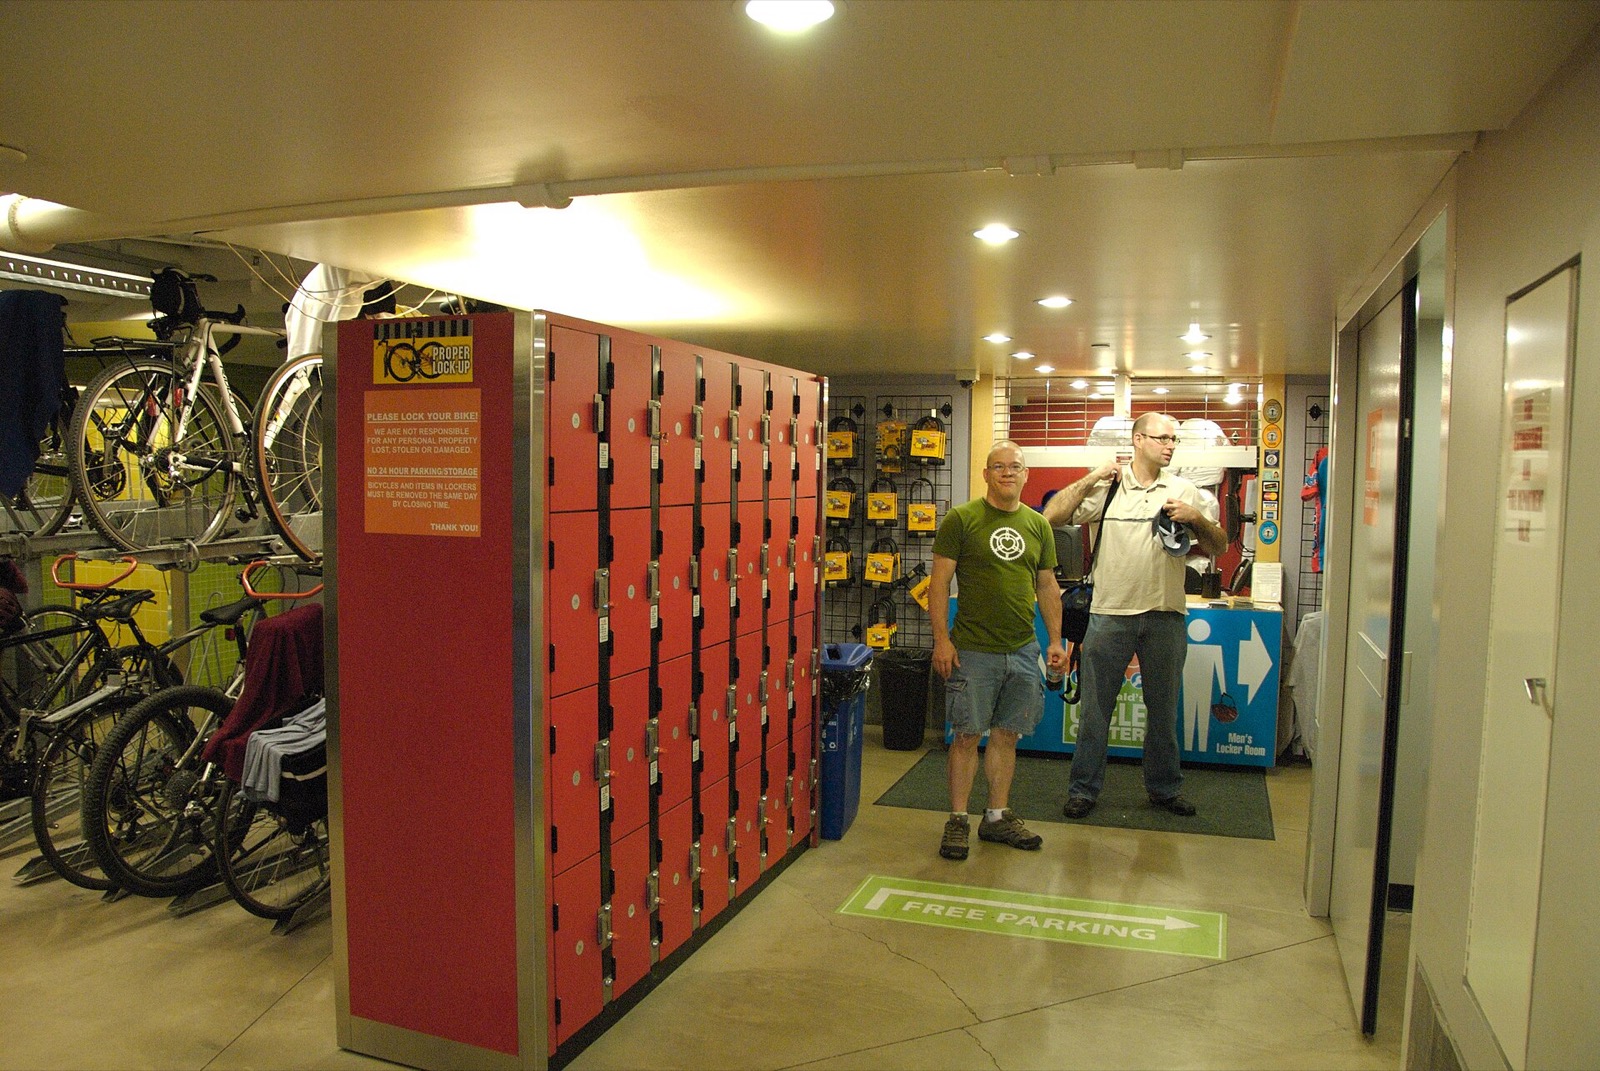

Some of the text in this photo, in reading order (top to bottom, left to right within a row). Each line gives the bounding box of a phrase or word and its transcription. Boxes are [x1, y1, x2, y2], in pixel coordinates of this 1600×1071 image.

[432, 345, 470, 360] PROPER
[432, 360, 470, 374] LOCK-UP
[367, 412, 478, 421] PLEASE LOCK YOUR BIKE!
[419, 427, 469, 435] RESPONSIBLE
[392, 446, 420, 454] STOLEN
[421, 446, 432, 454] OR
[367, 467, 378, 475] NO
[379, 467, 387, 475] 24
[388, 467, 409, 475] HOUR
[400, 482, 414, 490] AND
[415, 482, 435, 490] ITEMS
[444, 483, 477, 491] LOCKERS
[385, 491, 395, 499] BE
[395, 491, 428, 499] REMOVED
[443, 492, 462, 500] SAME
[463, 492, 478, 500] DAY
[392, 500, 401, 508] BY
[430, 523, 479, 532] THANK YOU!
[1227, 732, 1253, 744] Men's
[1216, 742, 1266, 756] Locker Room
[902, 901, 1156, 941] FREE PARKING
